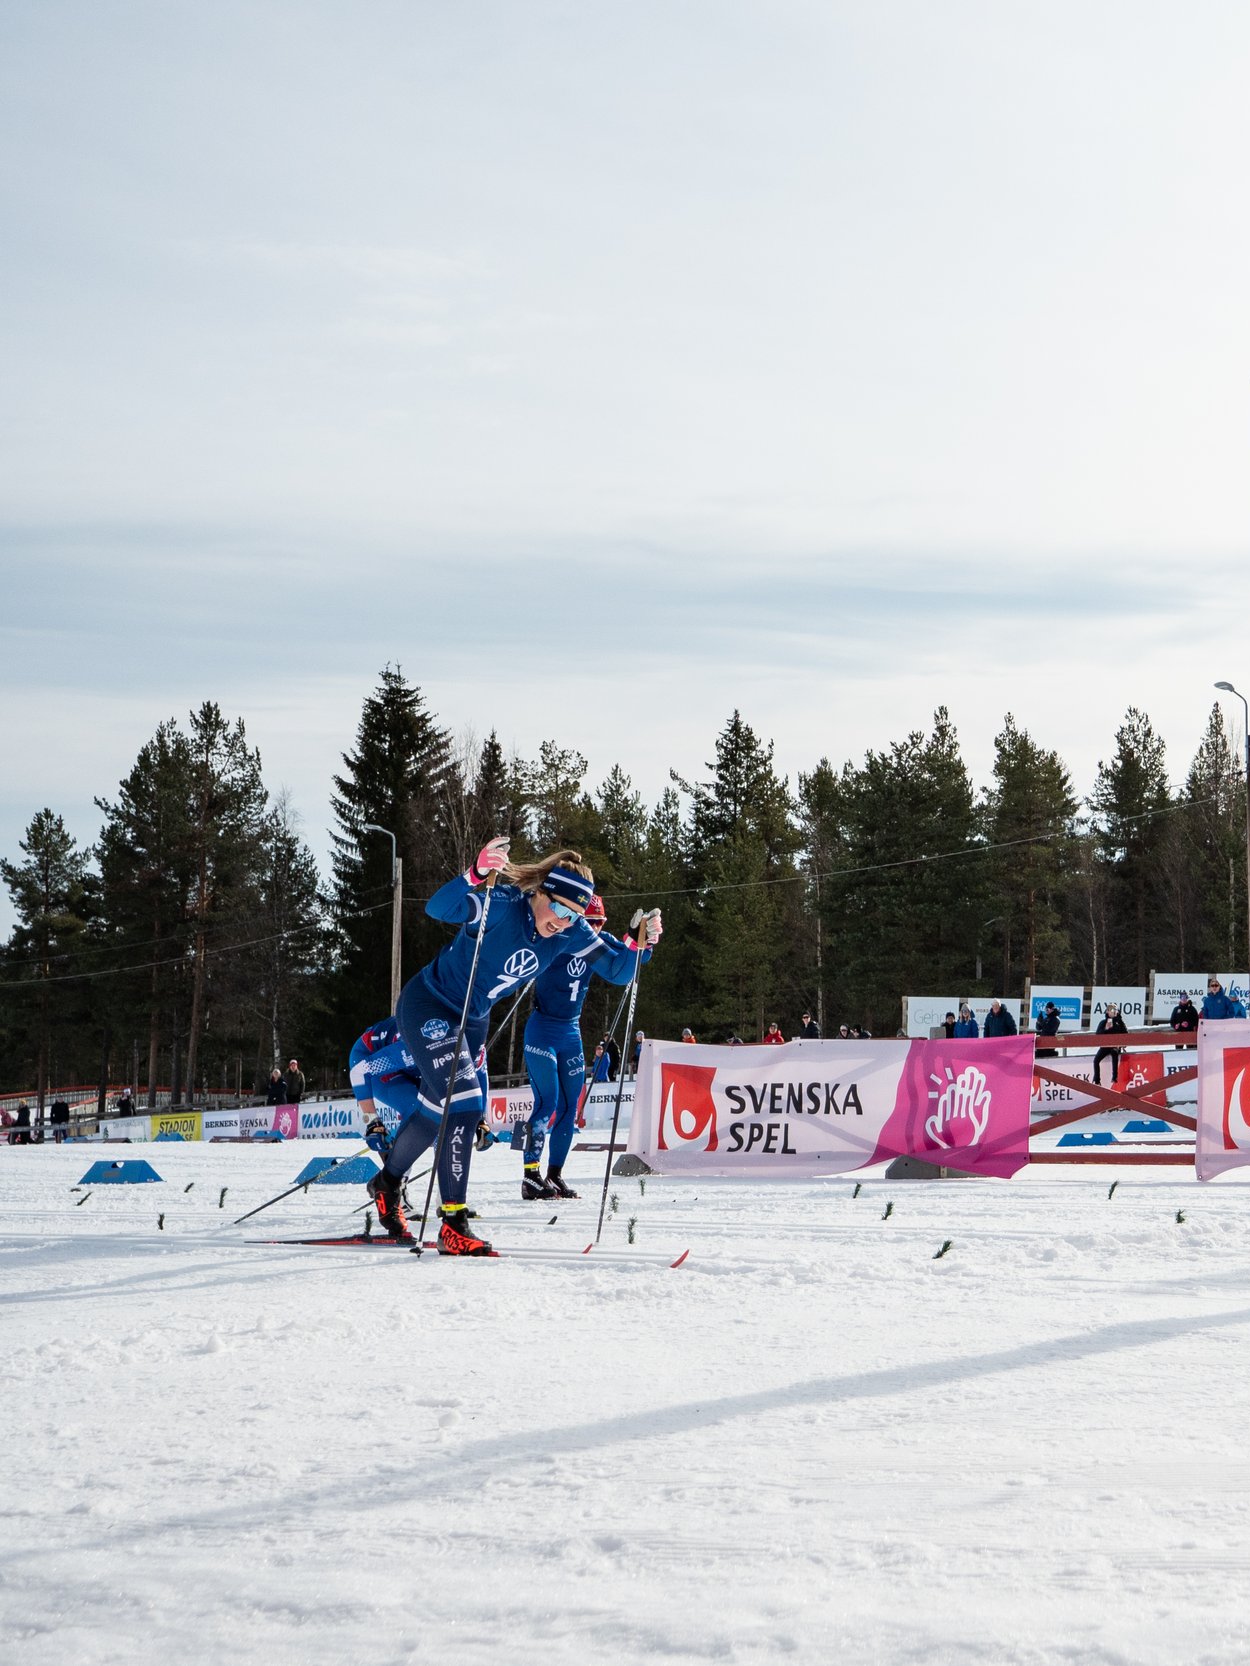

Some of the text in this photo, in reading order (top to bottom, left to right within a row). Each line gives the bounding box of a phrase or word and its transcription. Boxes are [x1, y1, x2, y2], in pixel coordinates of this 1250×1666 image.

[486, 974, 520, 999] 7
[569, 980, 580, 1002] 1
[1189, 988, 1204, 996] SÅG
[724, 1082, 863, 1115] SVENSKA
[1045, 1089, 1073, 1101] SPEL
[159, 1119, 195, 1134] STADION
[204, 1119, 239, 1129] BERNERS
[301, 1105, 352, 1129] monitor
[520, 1134, 528, 1150] 1
[727, 1122, 797, 1155] SPEL
[450, 1126, 465, 1182] HALLBY
